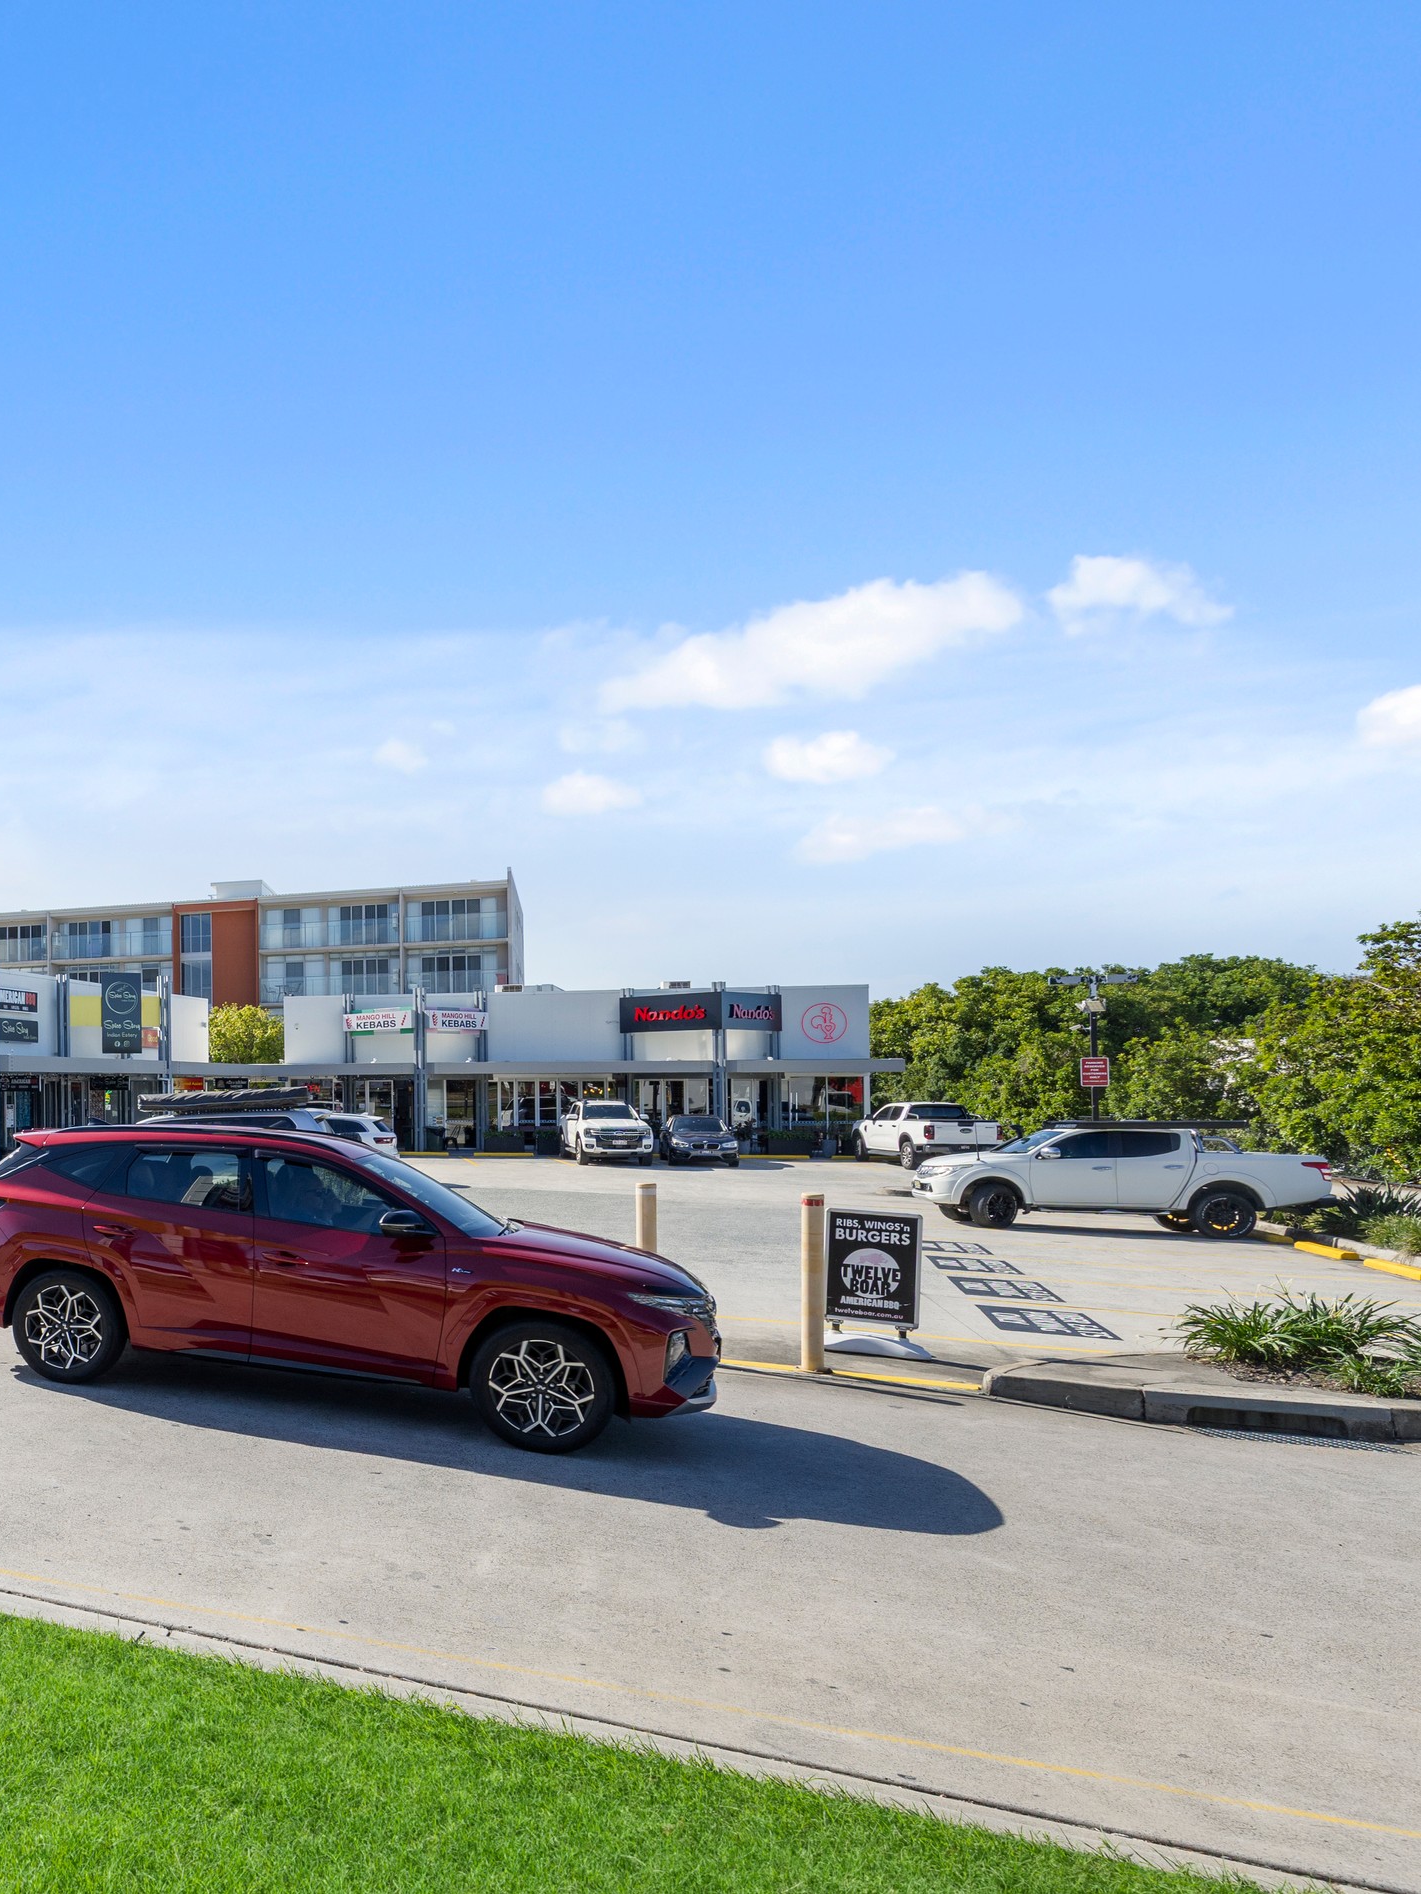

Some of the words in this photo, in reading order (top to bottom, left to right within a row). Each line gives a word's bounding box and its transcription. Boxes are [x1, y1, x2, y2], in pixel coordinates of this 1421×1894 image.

[356, 1013, 380, 1021] MANGO
[633, 1004, 706, 1021] Nando's
[730, 1003, 775, 1020] Nando's
[356, 1019, 396, 1029] KEBABS
[441, 1019, 477, 1028] KEBABS
[836, 1218, 861, 1228] RIBS,
[864, 1220, 910, 1233] WINGS'n
[835, 1228, 910, 1245] BURGERS
[841, 1263, 901, 1283] TWELVE
[849, 1279, 891, 1296] BOAR
[840, 1295, 883, 1308] AMERICAN
[883, 1300, 900, 1310] BBQ
[834, 1307, 904, 1319] twelveboar.com.au
